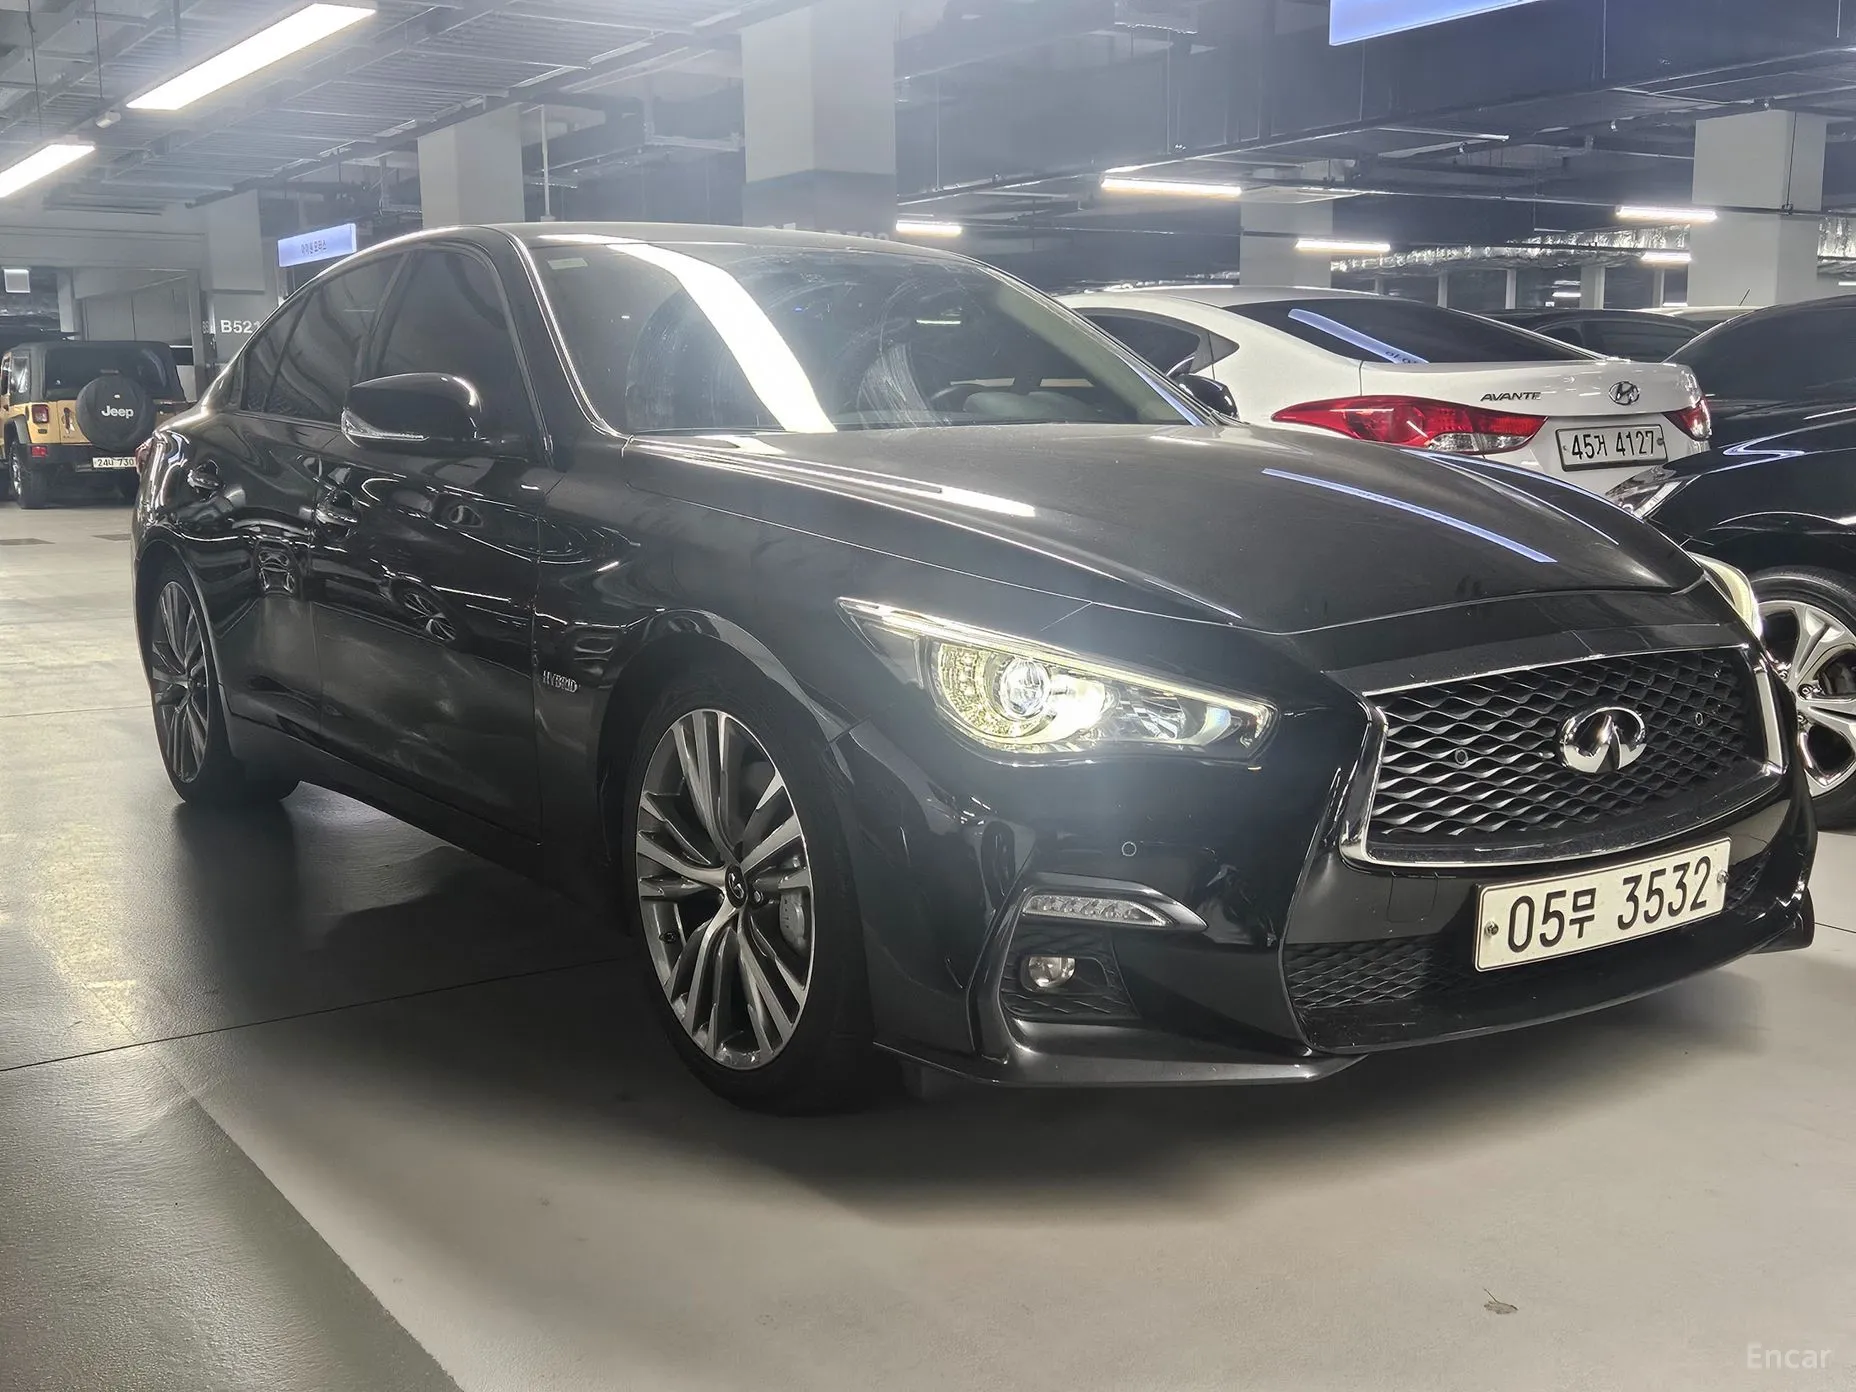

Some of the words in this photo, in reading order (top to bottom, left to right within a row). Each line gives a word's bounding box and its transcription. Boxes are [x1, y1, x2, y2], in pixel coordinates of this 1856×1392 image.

[1480, 391, 1542, 402] AVANTE
[101, 405, 134, 419] Jeep
[1571, 433, 1608, 460] 45거
[1615, 430, 1654, 456] 4127
[1507, 887, 1597, 953] 05무
[1617, 856, 1711, 930] 3532
